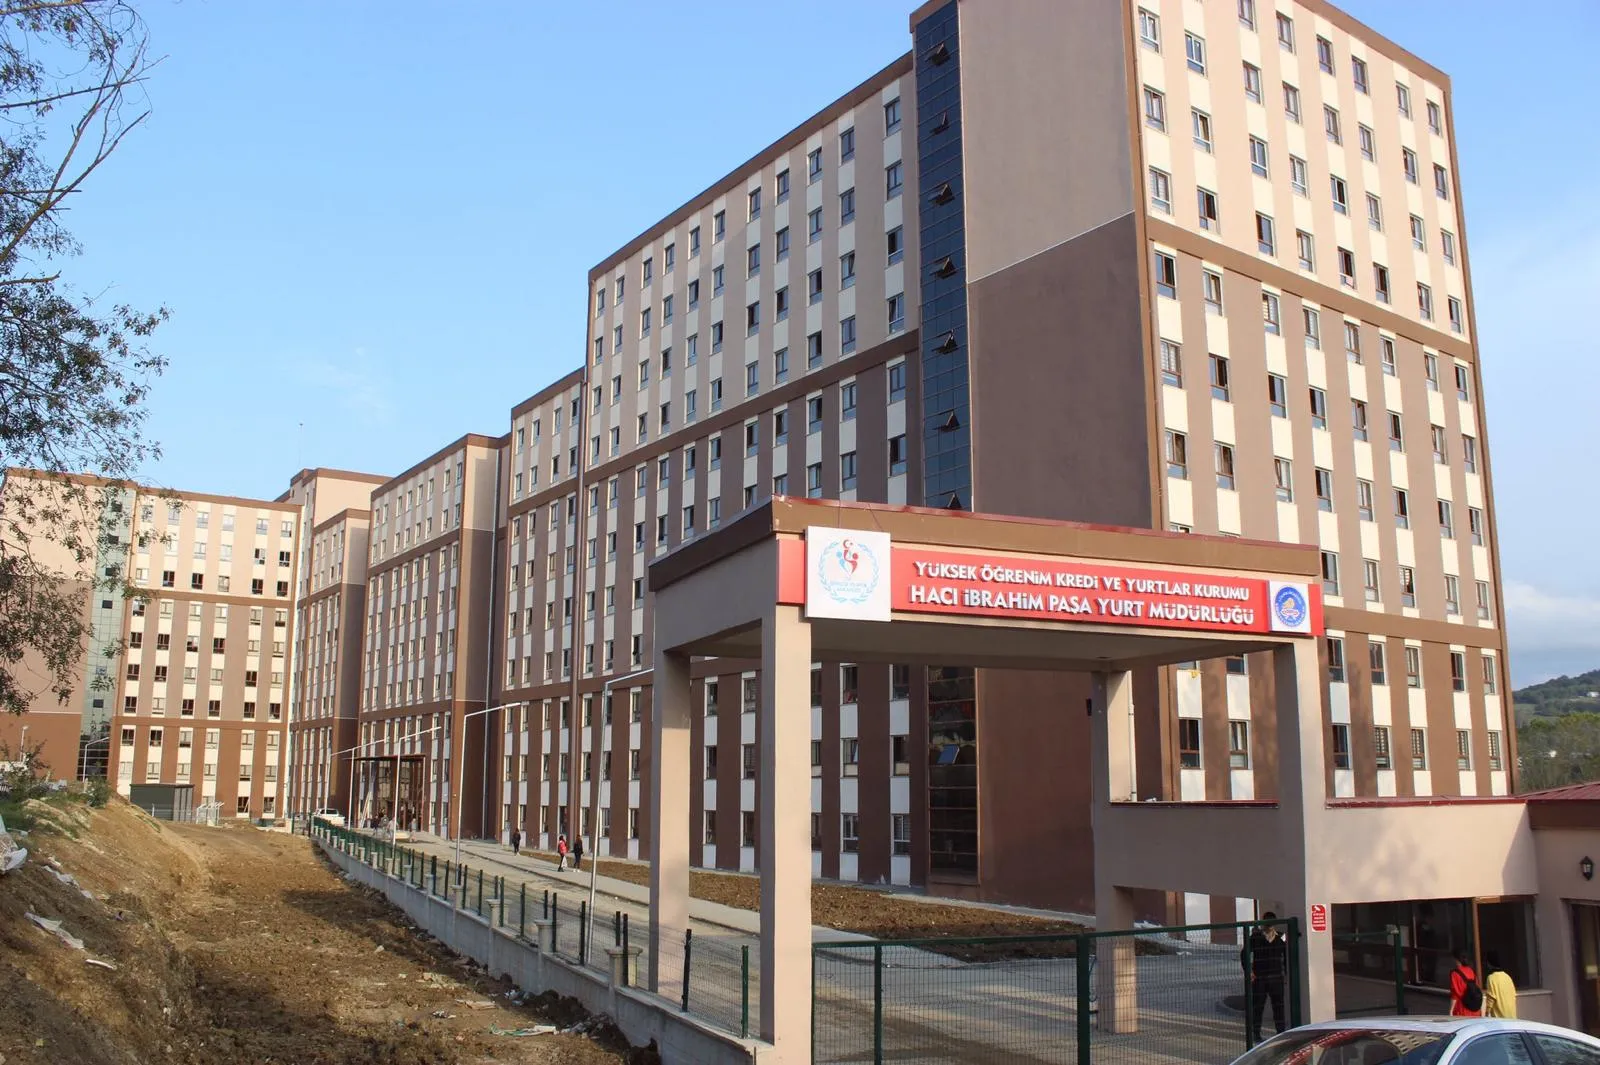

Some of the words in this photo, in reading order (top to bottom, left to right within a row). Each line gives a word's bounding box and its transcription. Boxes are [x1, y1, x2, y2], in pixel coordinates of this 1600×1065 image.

[915, 561, 977, 580] YÜKSEK
[981, 564, 1052, 585] ÖĞRENİM
[1056, 573, 1098, 589] KREDİ
[1102, 576, 1121, 590] VE
[1125, 578, 1191, 596] YURTLAR
[1194, 584, 1249, 601] KURUMU
[910, 585, 958, 605] HACI
[963, 589, 1044, 611] İBRAHİM
[1048, 594, 1092, 614] PAŞA
[1096, 598, 1145, 617] YURT
[1148, 602, 1254, 625] MÜDÜRLÜĞÜ
